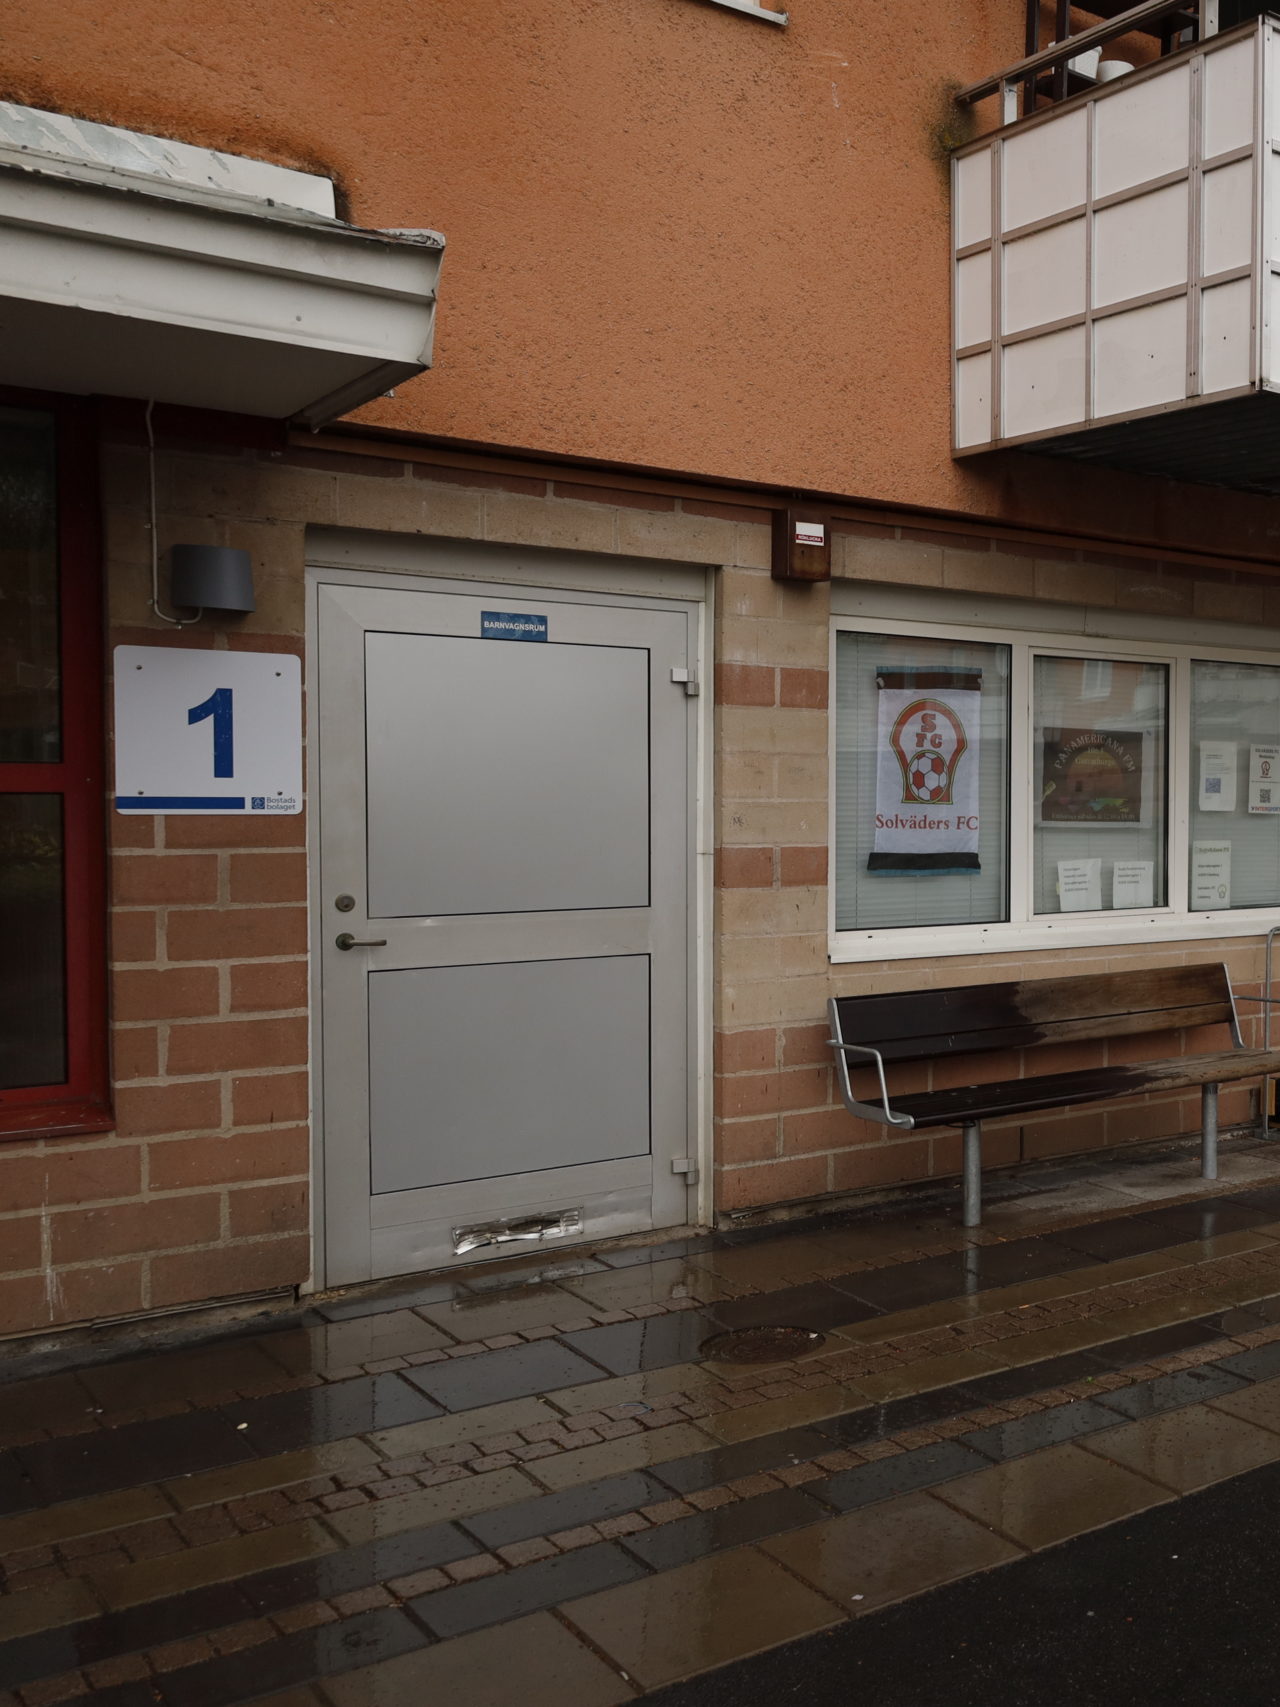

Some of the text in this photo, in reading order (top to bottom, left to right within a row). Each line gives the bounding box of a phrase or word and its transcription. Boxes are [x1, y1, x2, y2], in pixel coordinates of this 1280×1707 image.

[483, 620, 546, 632] BARNVAGNSRUM
[920, 712, 937, 733] S
[188, 688, 234, 779] 1
[1054, 734, 1137, 772] PANAMERICANA FM
[266, 796, 296, 804] Bostads
[266, 804, 296, 812] bolaget
[875, 814, 980, 831] Solväders FC
